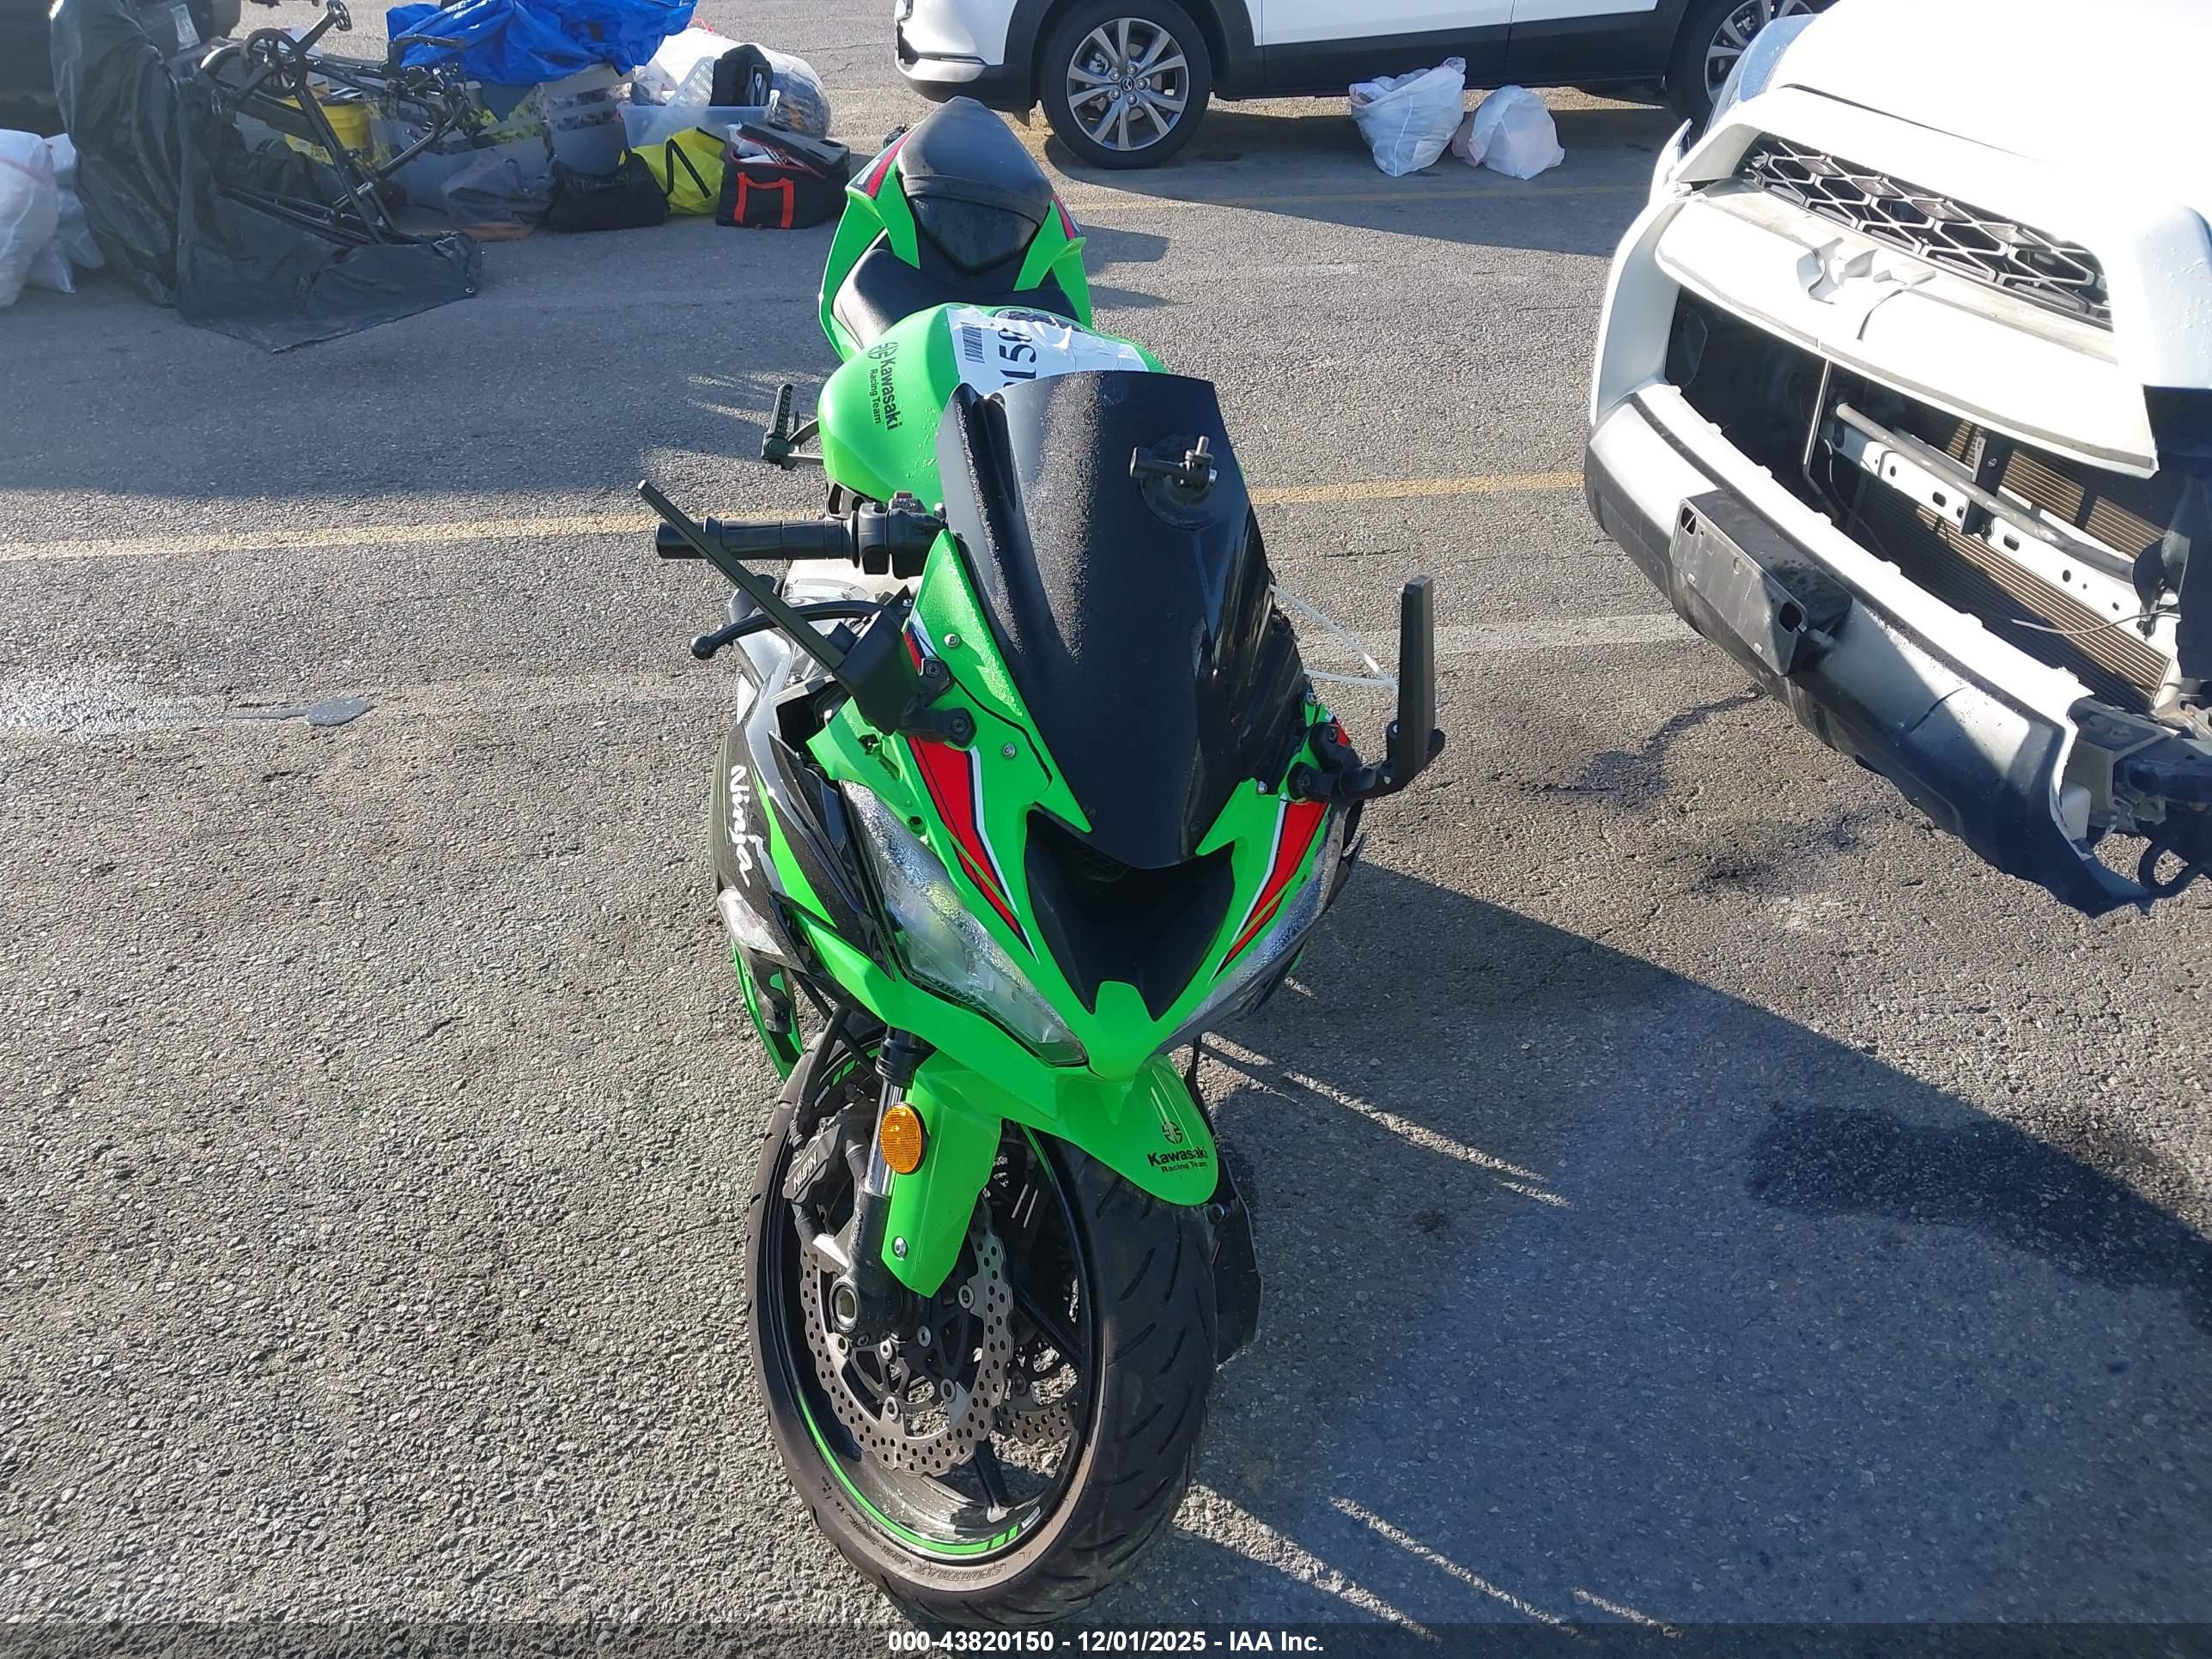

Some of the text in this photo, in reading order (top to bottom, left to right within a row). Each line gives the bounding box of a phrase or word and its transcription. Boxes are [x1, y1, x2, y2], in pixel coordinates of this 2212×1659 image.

[870, 368, 882, 424] Racing Team
[880, 357, 902, 430] Kawasaki
[727, 764, 757, 888] Ninja
[793, 1151, 818, 1192] NISSIN
[1147, 1146, 1209, 1167] Kawasaki
[1161, 1163, 1190, 1173] Racing
